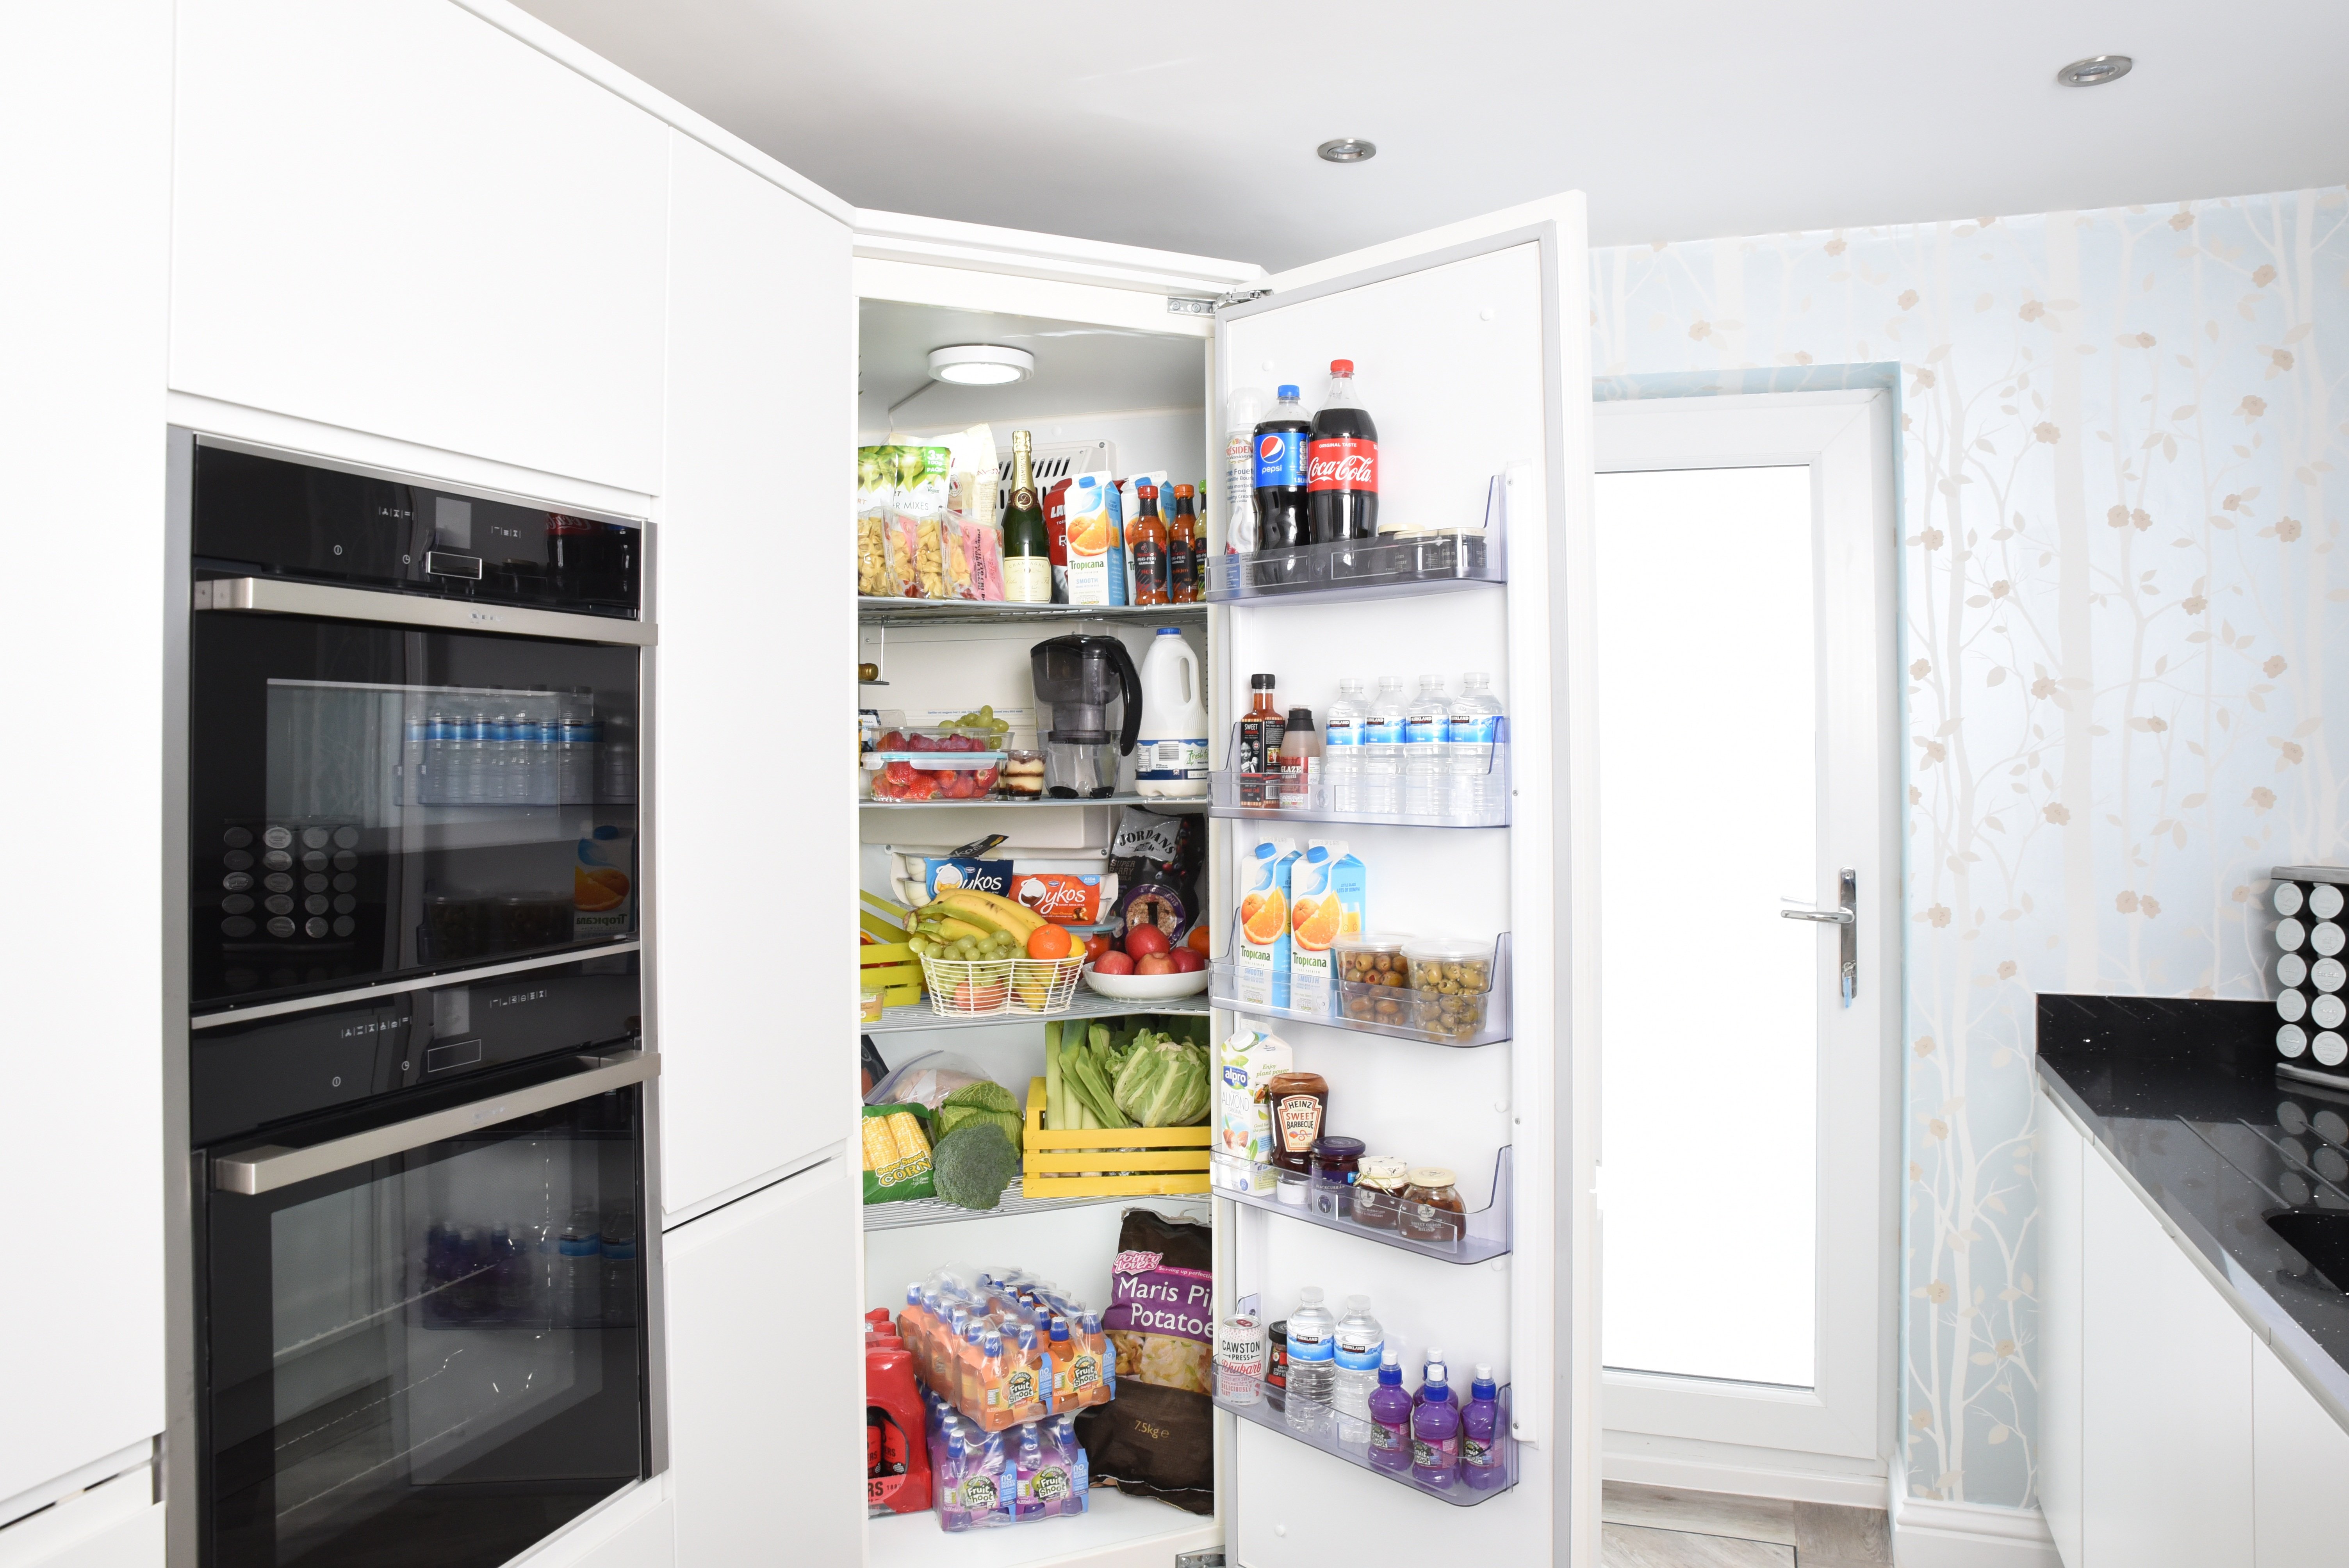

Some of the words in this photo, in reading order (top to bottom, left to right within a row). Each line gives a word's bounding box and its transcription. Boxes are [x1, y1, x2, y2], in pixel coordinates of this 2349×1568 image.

[1262, 465, 1282, 474] pepsi
[1308, 455, 1373, 483] Coca-Cola
[904, 502, 929, 510] MIXES
[1069, 560, 1104, 570] Tropicana
[1120, 830, 1176, 854] JORDANS
[1018, 877, 1085, 914] Oykos
[1241, 945, 1270, 961] Tropicana
[1293, 952, 1326, 968] Tropicana
[1244, 968, 1263, 977] SMOOTH
[1297, 975, 1319, 984] SMOOTH
[1225, 1068, 1246, 1083] alpro
[1222, 1092, 1249, 1111] ALMOND
[1289, 1101, 1312, 1109] HEINZ
[1287, 1121, 1314, 1130] BARBECUE
[877, 1161, 901, 1175] Super
[901, 1151, 926, 1165] Sweet
[880, 1158, 932, 1186] CORN
[1117, 1253, 1160, 1263] Potato
[1117, 1261, 1157, 1271] Lovers
[1118, 1277, 1179, 1302] Maris
[1222, 1340, 1260, 1353] CAWSTON
[1075, 1365, 1094, 1378] Fruit
[1221, 1359, 1262, 1374] Rhubarb
[1011, 1373, 1030, 1383] ROBINSONS
[1074, 1371, 1097, 1386] Shoot
[1010, 1381, 1030, 1393] Fruit
[1221, 1384, 1251, 1392] DELICIOUSLY
[1009, 1389, 1032, 1402] Shoot
[1135, 1420, 1159, 1438] 7.5kg
[1042, 1467, 1063, 1477] ROBINSONS
[1041, 1476, 1062, 1487] Fruit
[968, 1486, 989, 1496] Fruit
[1039, 1484, 1066, 1497] Shoot
